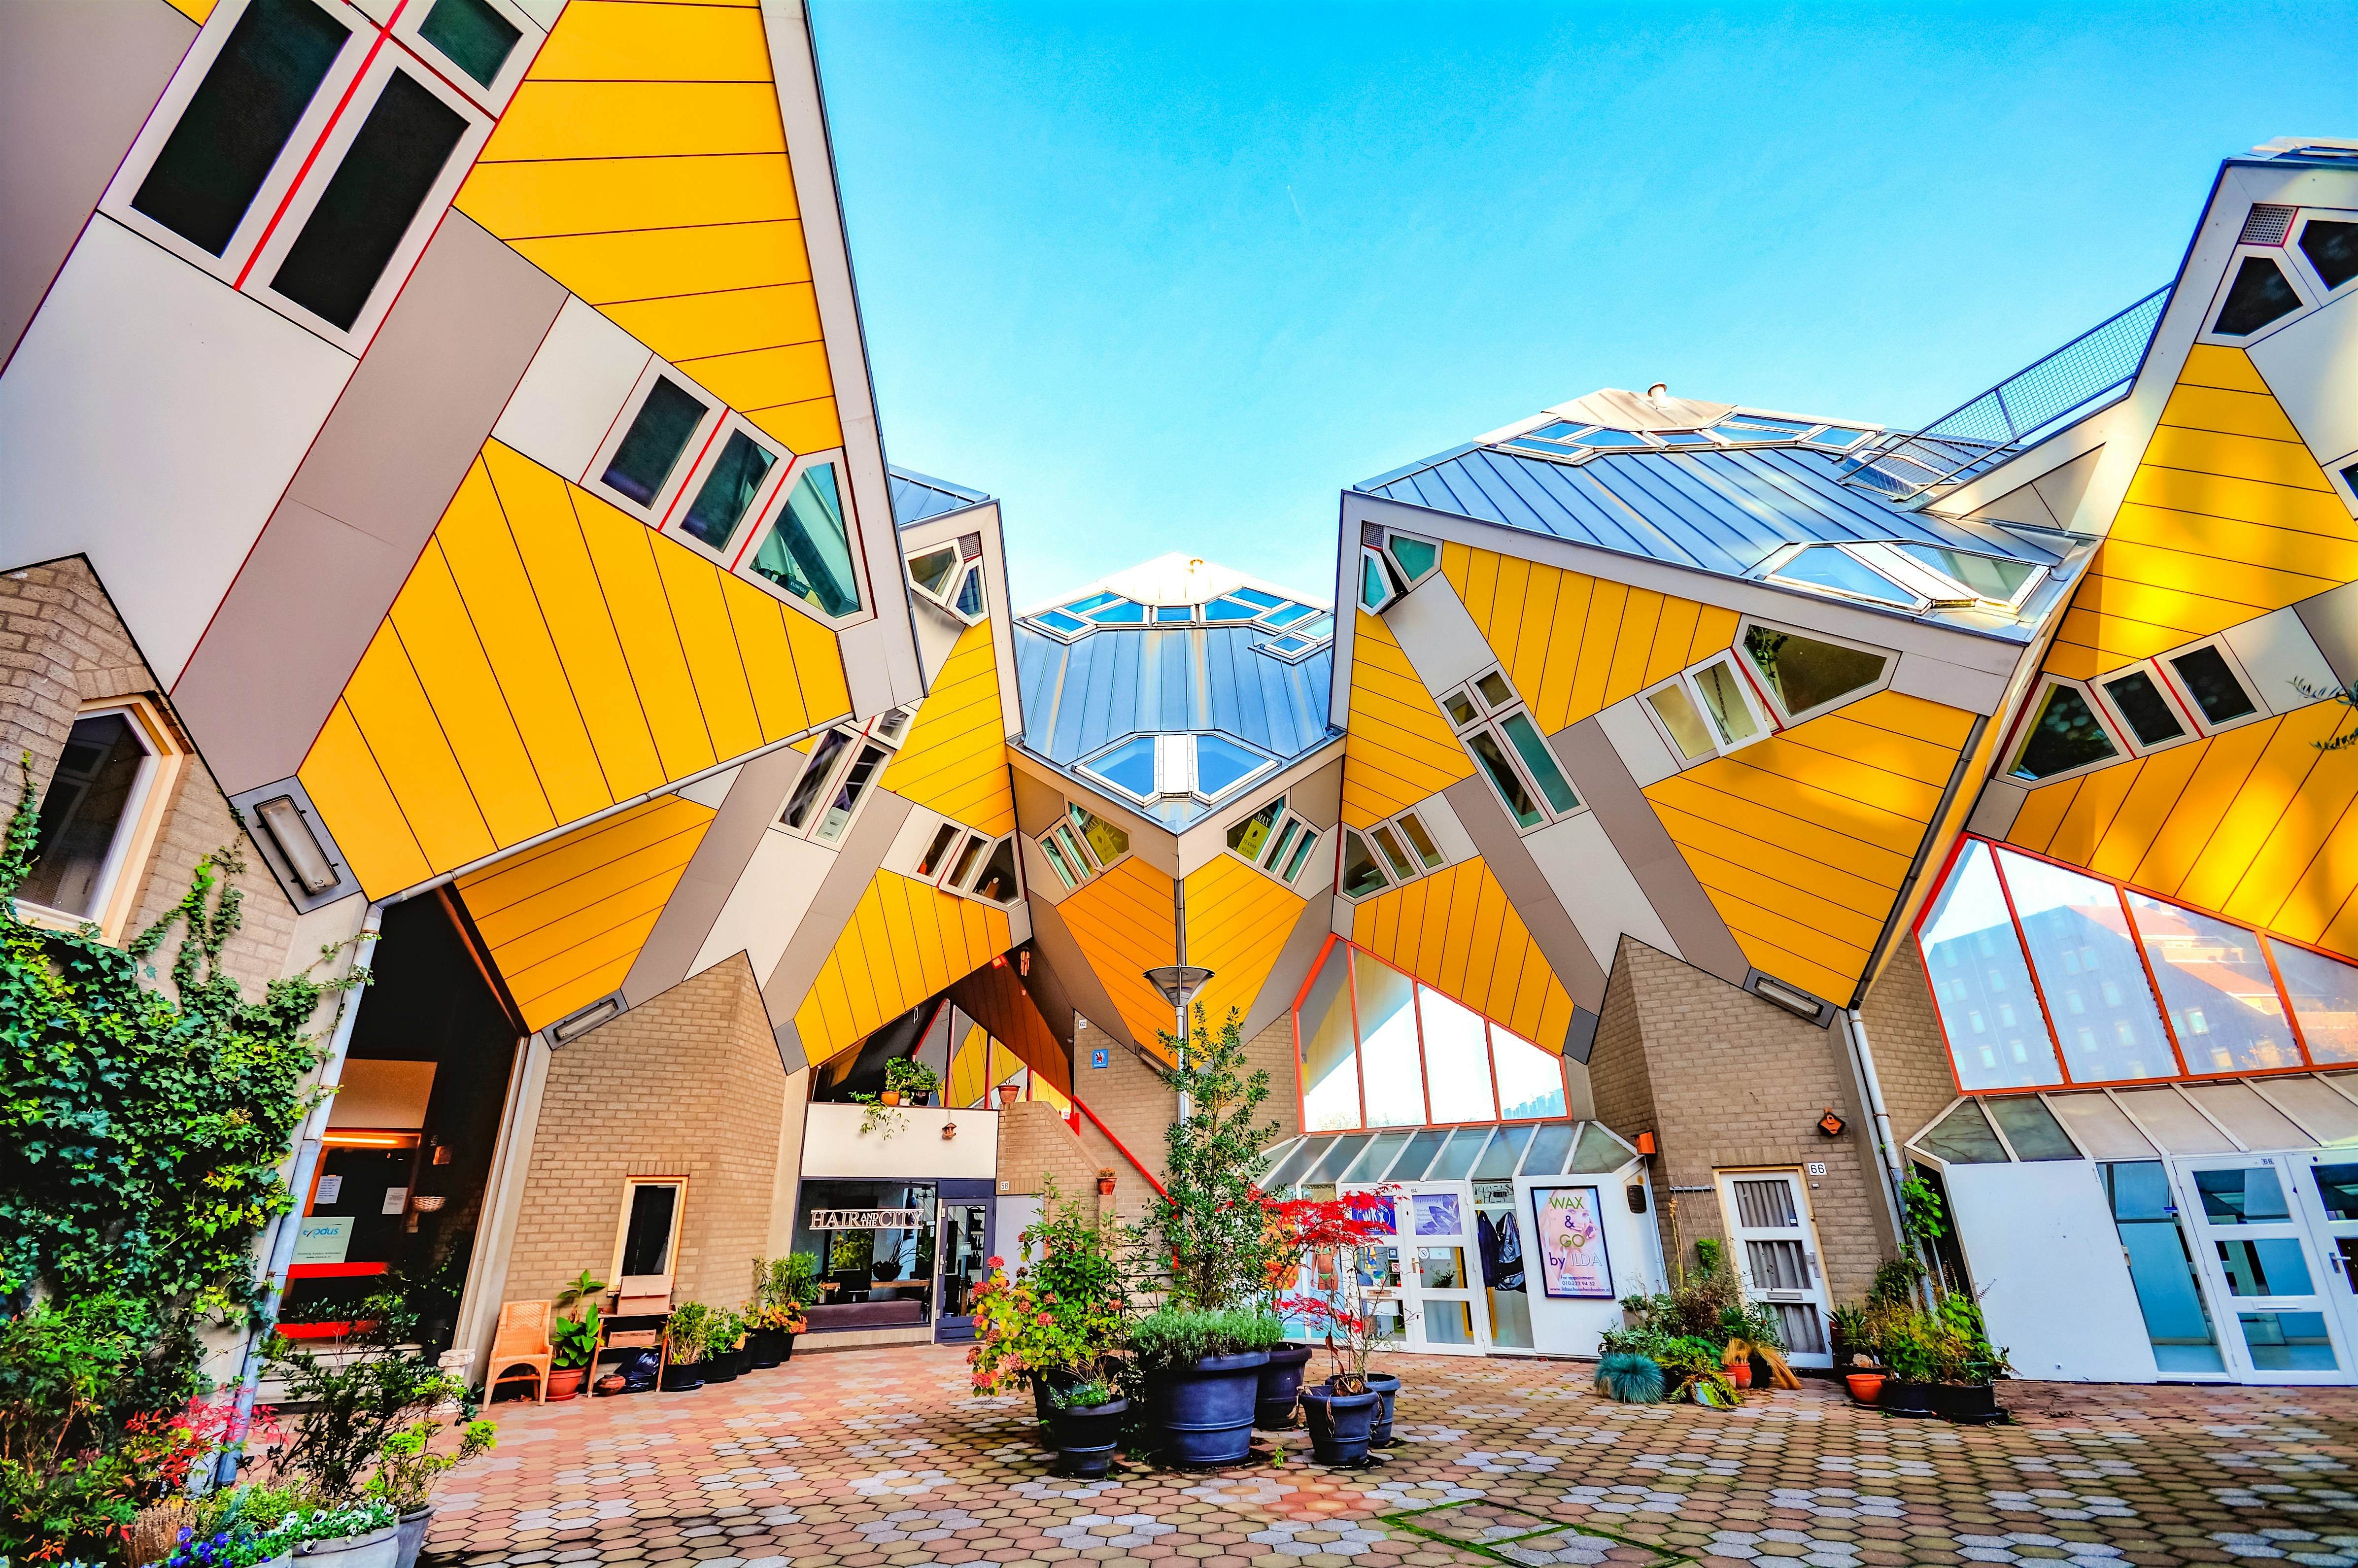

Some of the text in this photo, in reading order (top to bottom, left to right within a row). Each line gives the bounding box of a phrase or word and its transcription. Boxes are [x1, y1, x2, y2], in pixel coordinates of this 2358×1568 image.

[790, 581, 807, 593] FLOWERS
[1256, 812, 1270, 826] MAX
[1811, 1164, 1824, 1173] 66
[1549, 1196, 1584, 1210] WAX
[809, 1212, 861, 1228] HAIR
[878, 1211, 924, 1227] CITY
[1565, 1215, 1575, 1228] &
[303, 1227, 340, 1238] exodus
[1559, 1234, 1585, 1247] GO
[1549, 1252, 1602, 1270] by ILDA
